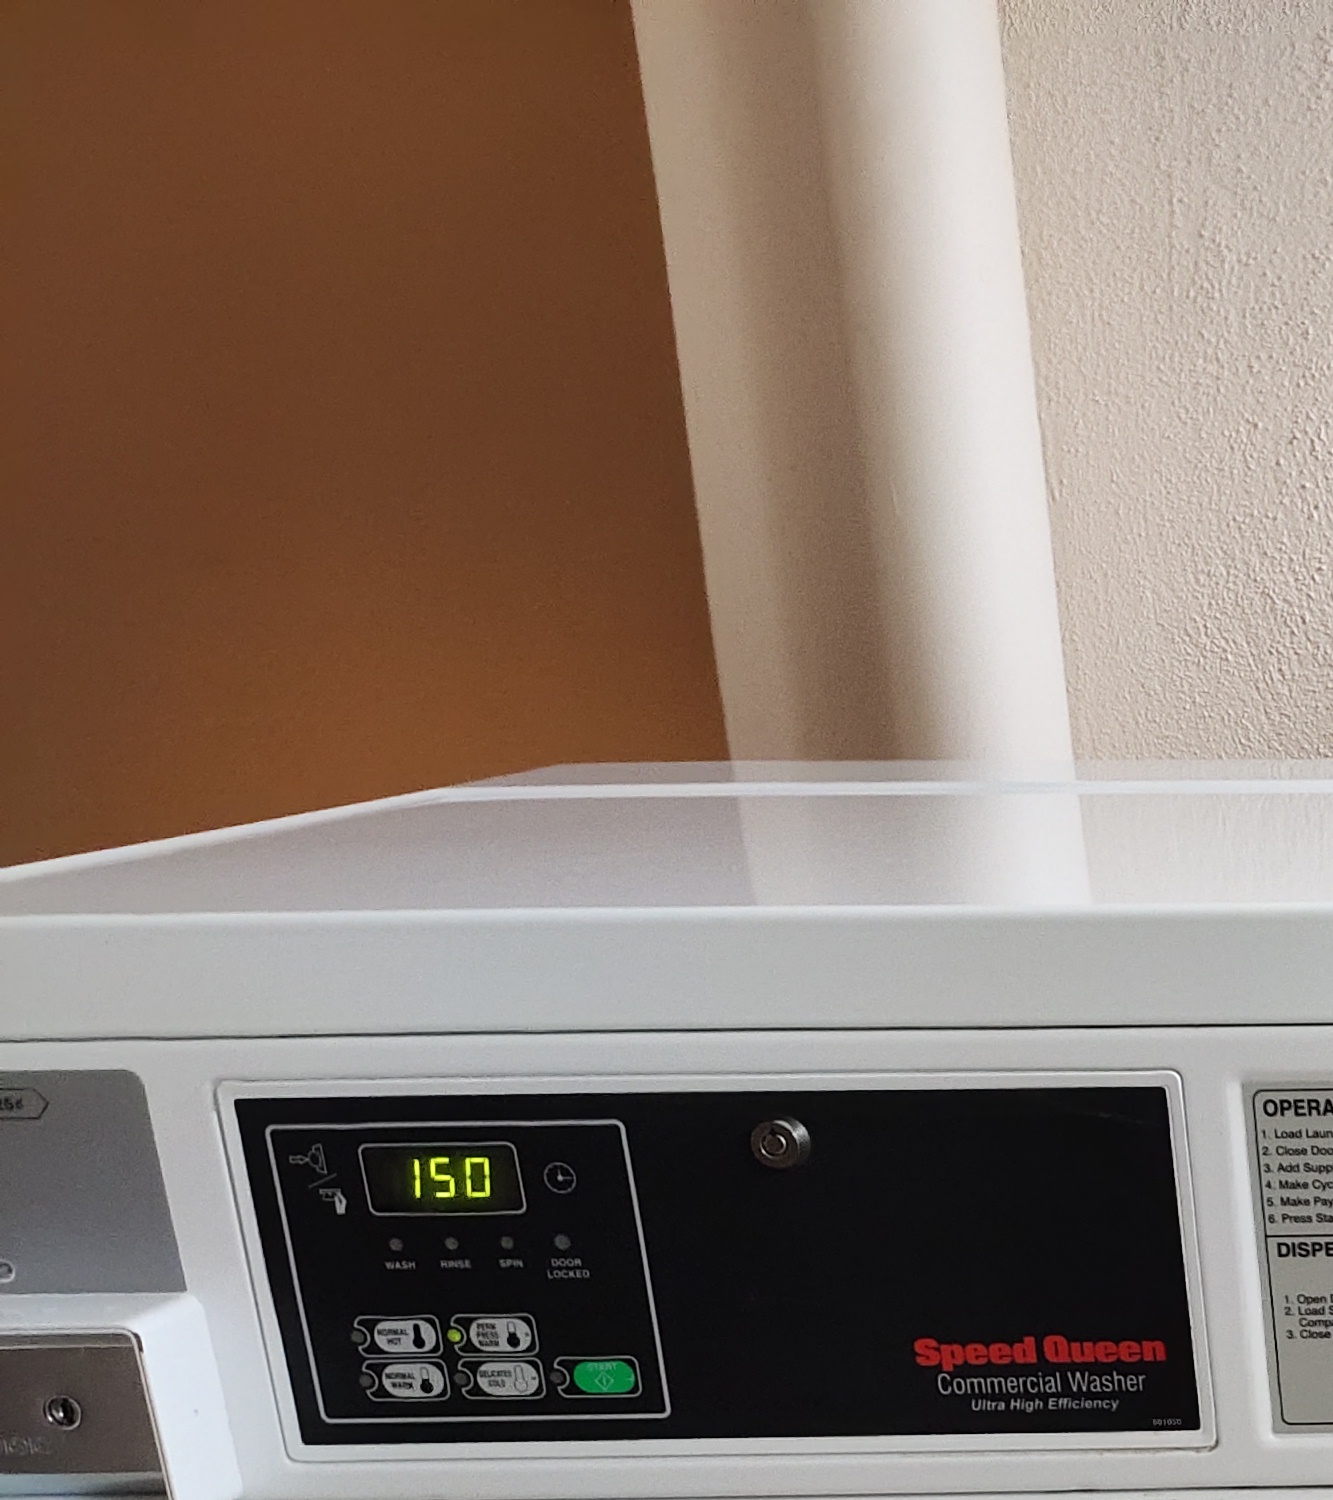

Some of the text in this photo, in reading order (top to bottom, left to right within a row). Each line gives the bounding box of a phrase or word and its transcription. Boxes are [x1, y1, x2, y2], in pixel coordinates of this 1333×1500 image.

[1273, 1128, 1302, 1139] Load
[1275, 1145, 1307, 1156] Close
[1276, 1162, 1300, 1173] Add
[413, 1157, 491, 1198] 150
[1278, 1179, 1309, 1189] Make
[1279, 1196, 1310, 1206] Make
[1281, 1212, 1313, 1223] Press
[384, 1260, 415, 1269] WASH
[440, 1259, 471, 1268] RINSE
[498, 1258, 523, 1267] SPIN
[550, 1258, 581, 1266] DOOR
[546, 1269, 589, 1278] LOCKED
[913, 1334, 1166, 1371] Speed Queen
[937, 1370, 1145, 1394] Commercial Washer
[971, 1397, 1118, 1412] Ultra High Efficiency
